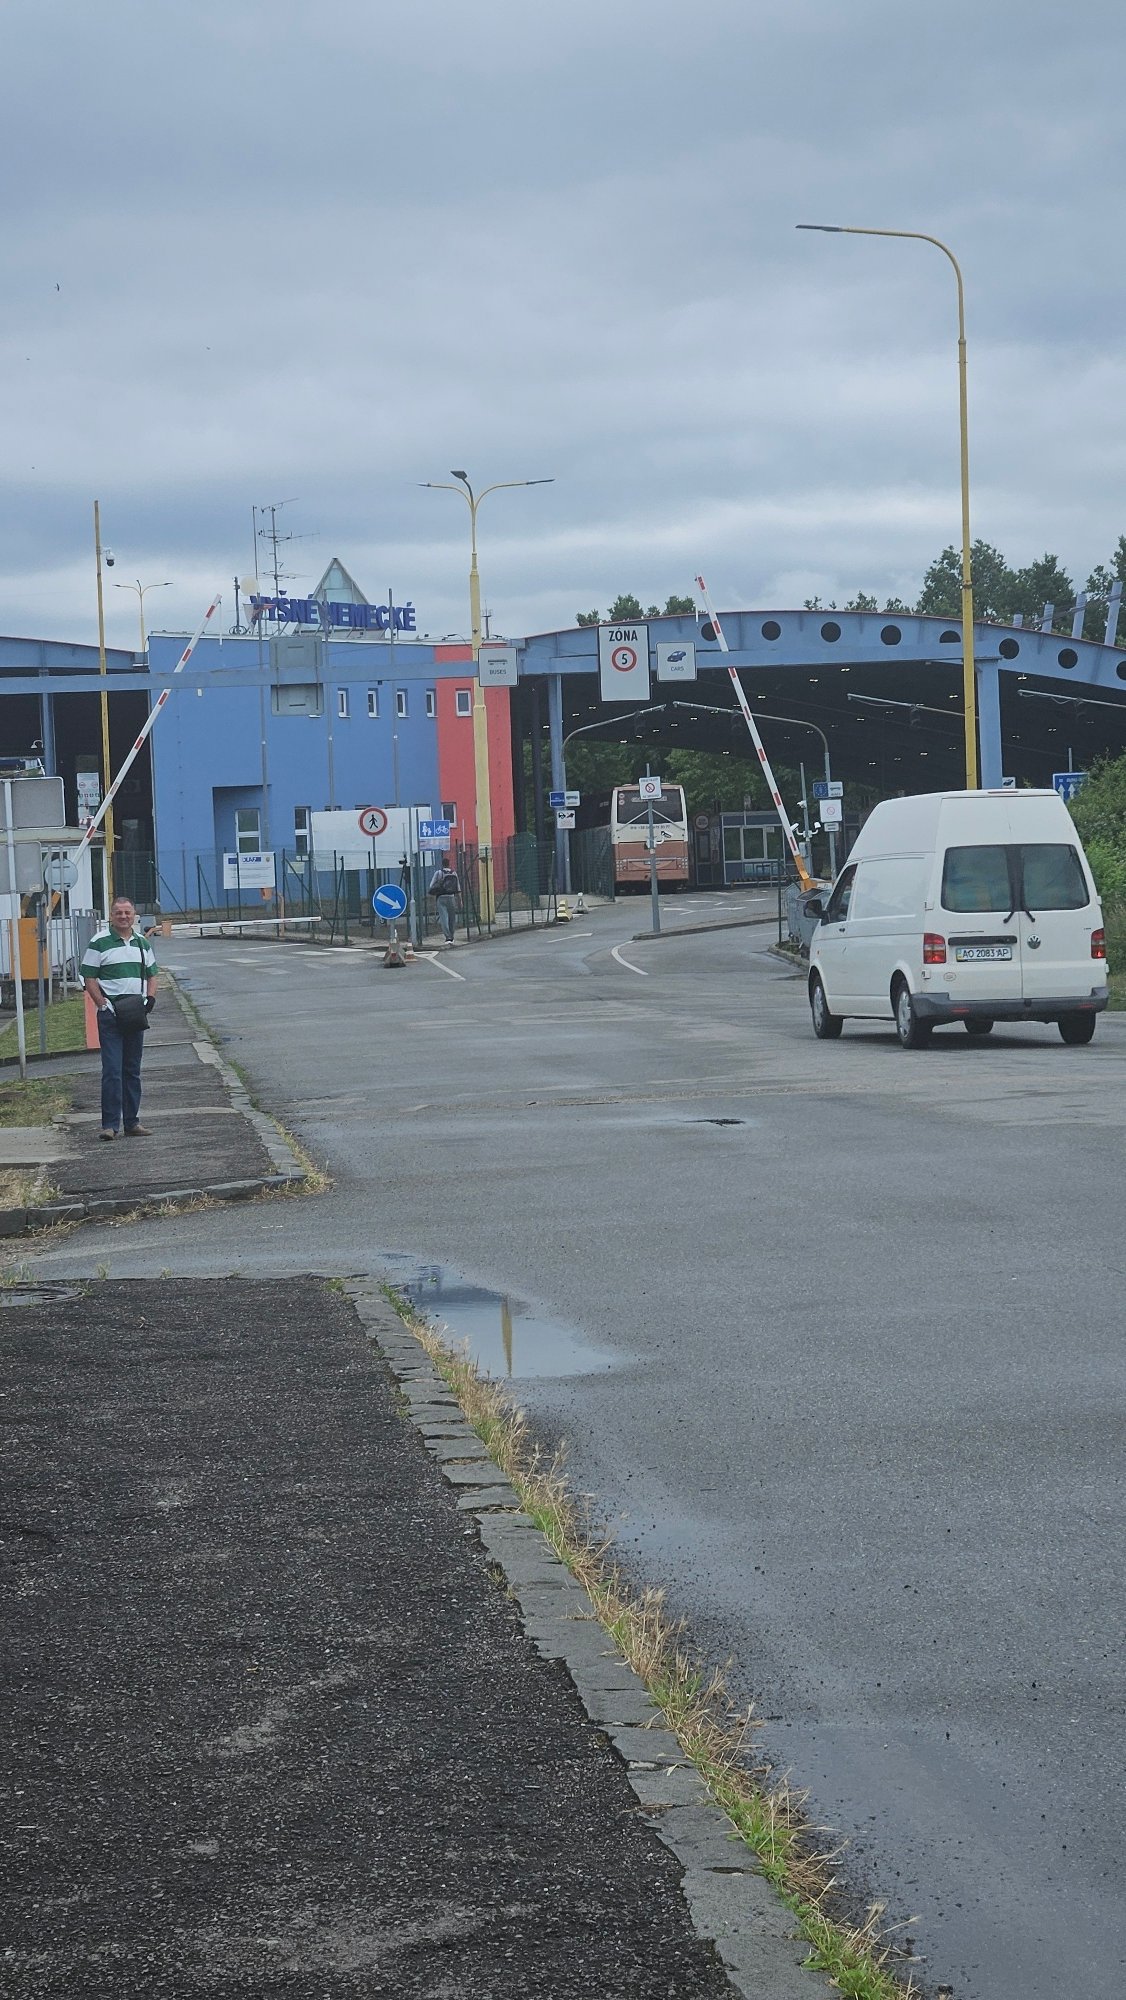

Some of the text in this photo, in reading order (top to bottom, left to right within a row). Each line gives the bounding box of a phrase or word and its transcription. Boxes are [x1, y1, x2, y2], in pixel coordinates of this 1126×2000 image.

[608, 627, 638, 642] ZÓNA
[621, 653, 628, 665] 5
[976, 949, 995, 958] 2083
[996, 948, 1009, 957] AP
